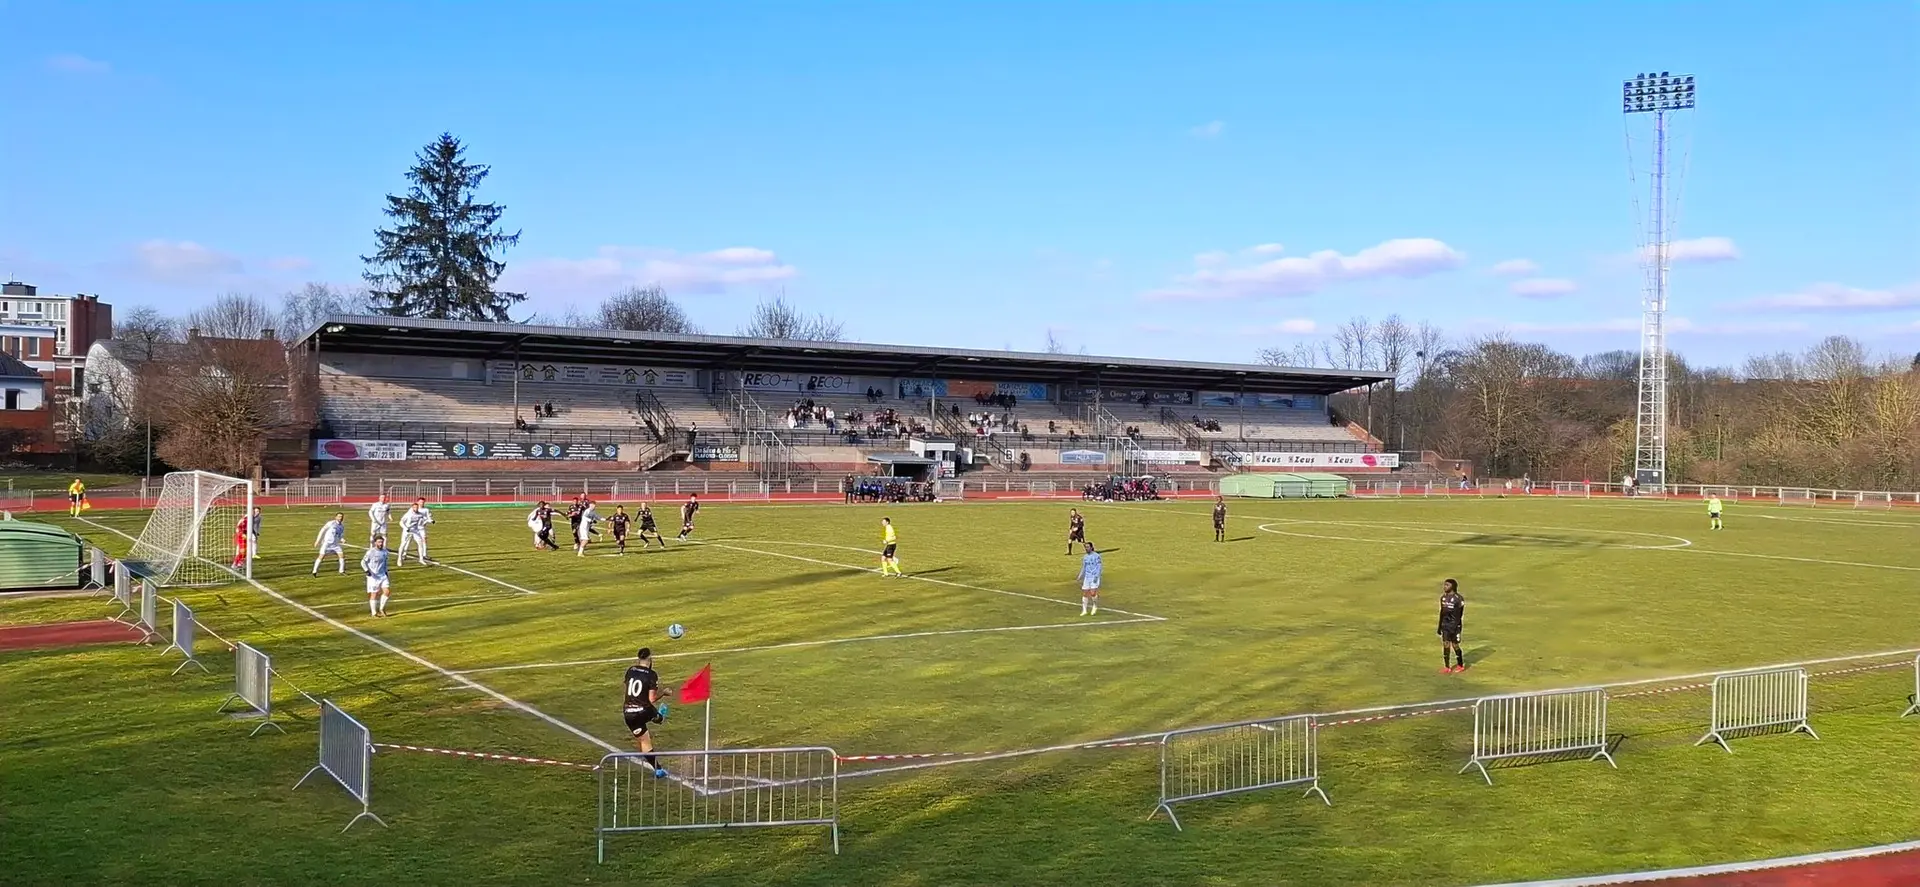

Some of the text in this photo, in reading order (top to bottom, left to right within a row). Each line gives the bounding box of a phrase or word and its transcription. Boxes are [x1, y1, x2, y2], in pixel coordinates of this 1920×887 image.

[744, 373, 792, 387] RECO+
[807, 375, 854, 389] RECO+
[1245, 453, 1251, 462] C
[1261, 455, 1281, 463] Zeus
[1294, 455, 1315, 463] Zeus
[1334, 456, 1354, 464] Zeus
[628, 678, 642, 697] 10
